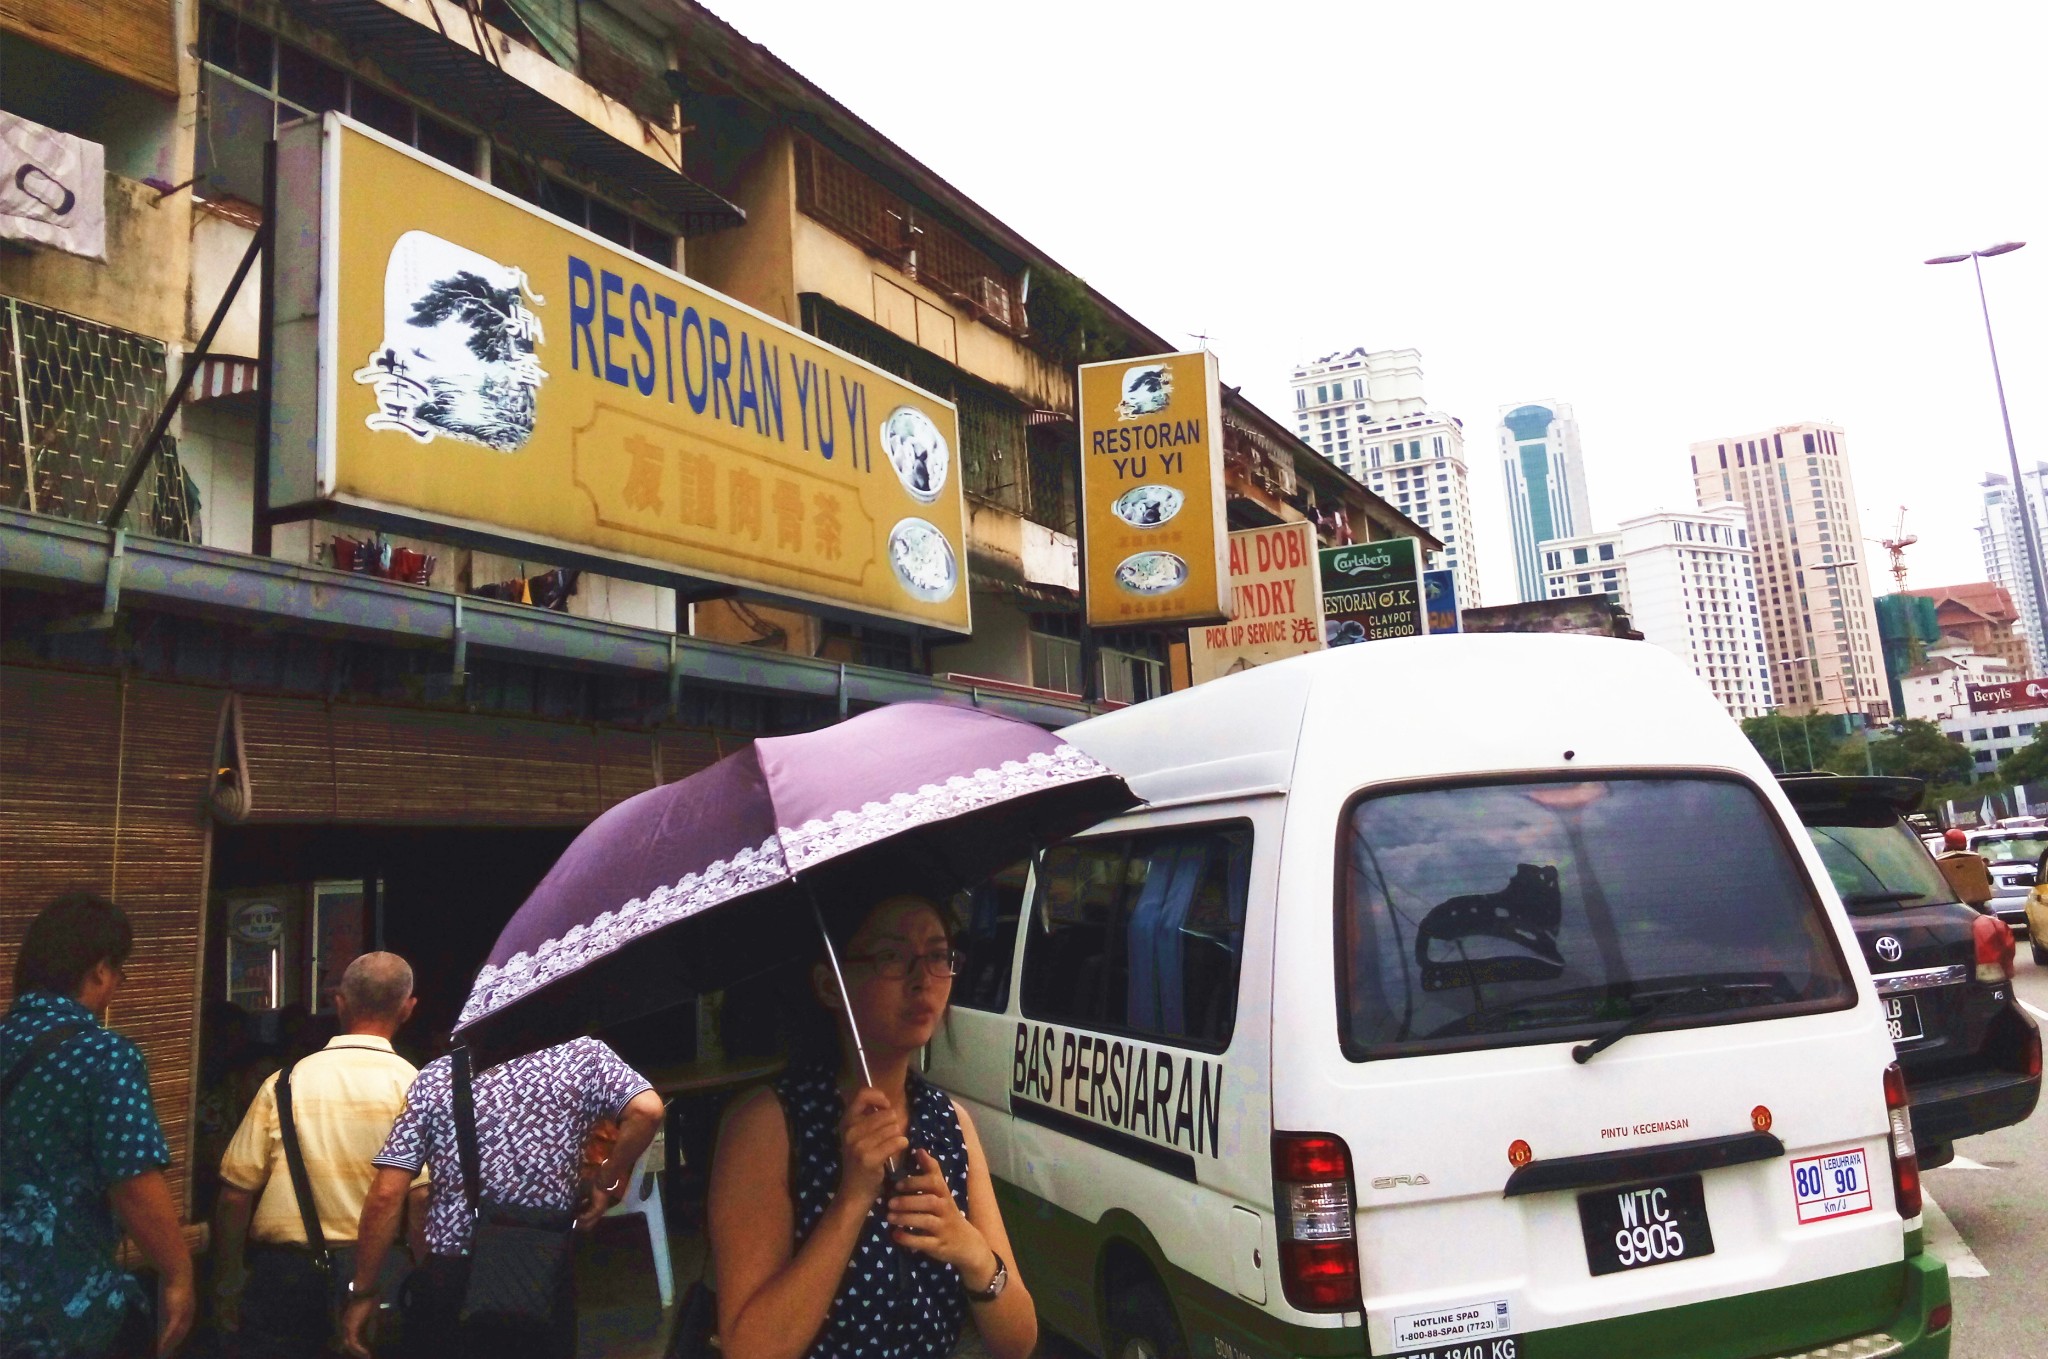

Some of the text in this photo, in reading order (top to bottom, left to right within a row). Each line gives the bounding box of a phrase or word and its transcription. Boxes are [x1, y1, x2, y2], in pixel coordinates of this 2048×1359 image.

[568, 255, 871, 473] RESTORAN YU YI
[1093, 419, 1200, 456] RESTORAN
[1113, 452, 1183, 479] YU YI
[1256, 528, 1307, 573] DOBI
[1334, 551, 1391, 573] Carlsberg
[1323, 591, 1377, 615] ESTORAN
[1291, 617, 1317, 644] 洗
[1369, 611, 1411, 626] CLAYPOT
[1206, 620, 1286, 650] PICK UP SERVICE
[1370, 624, 1414, 640] SEAFOOD
[1973, 687, 2012, 704] Beryl's
[1013, 1022, 1223, 1159] BAS PERSIARAN
[1601, 1118, 1689, 1139] PINTU KECEMASAN
[1824, 1154, 1861, 1171] LEBUHRAYA
[1796, 1165, 1821, 1197] 80
[1835, 1167, 1857, 1193] 90
[1617, 1187, 1669, 1229] WTC
[1615, 1220, 1684, 1266] 9905
[1400, 1320, 1494, 1341] 1-800-88-SPAD (7723)
[1413, 1311, 1479, 1328] HOTLINE SPAD
[1492, 1339, 1515, 1359] KG
